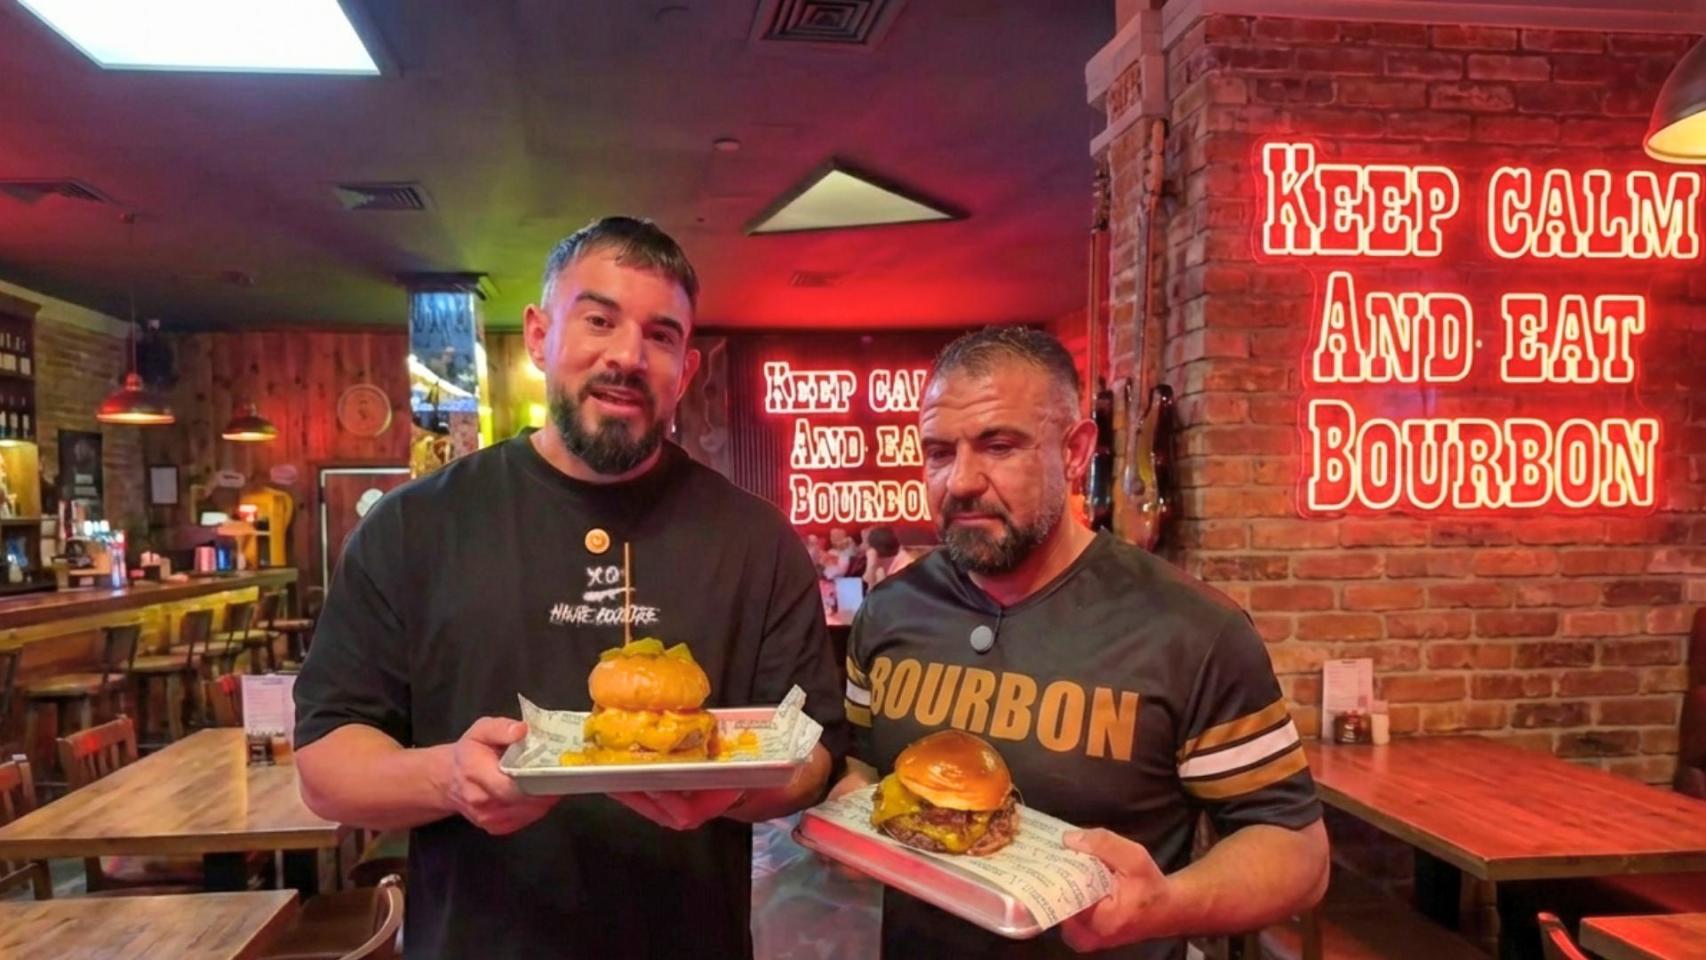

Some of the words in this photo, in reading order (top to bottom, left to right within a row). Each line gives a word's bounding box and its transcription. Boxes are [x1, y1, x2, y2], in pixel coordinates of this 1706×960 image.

[1262, 143, 1459, 256] KEEP
[1487, 167, 1700, 259] CALM
[1313, 271, 1473, 382] AND
[1501, 293, 1645, 382] EAT
[764, 361, 857, 413] KEEP
[790, 418, 864, 469] AND
[876, 425, 924, 467] EA
[1309, 398, 1658, 510] BOURBON
[789, 474, 931, 525] BOURBO
[869, 656, 1139, 761] BOURBON
